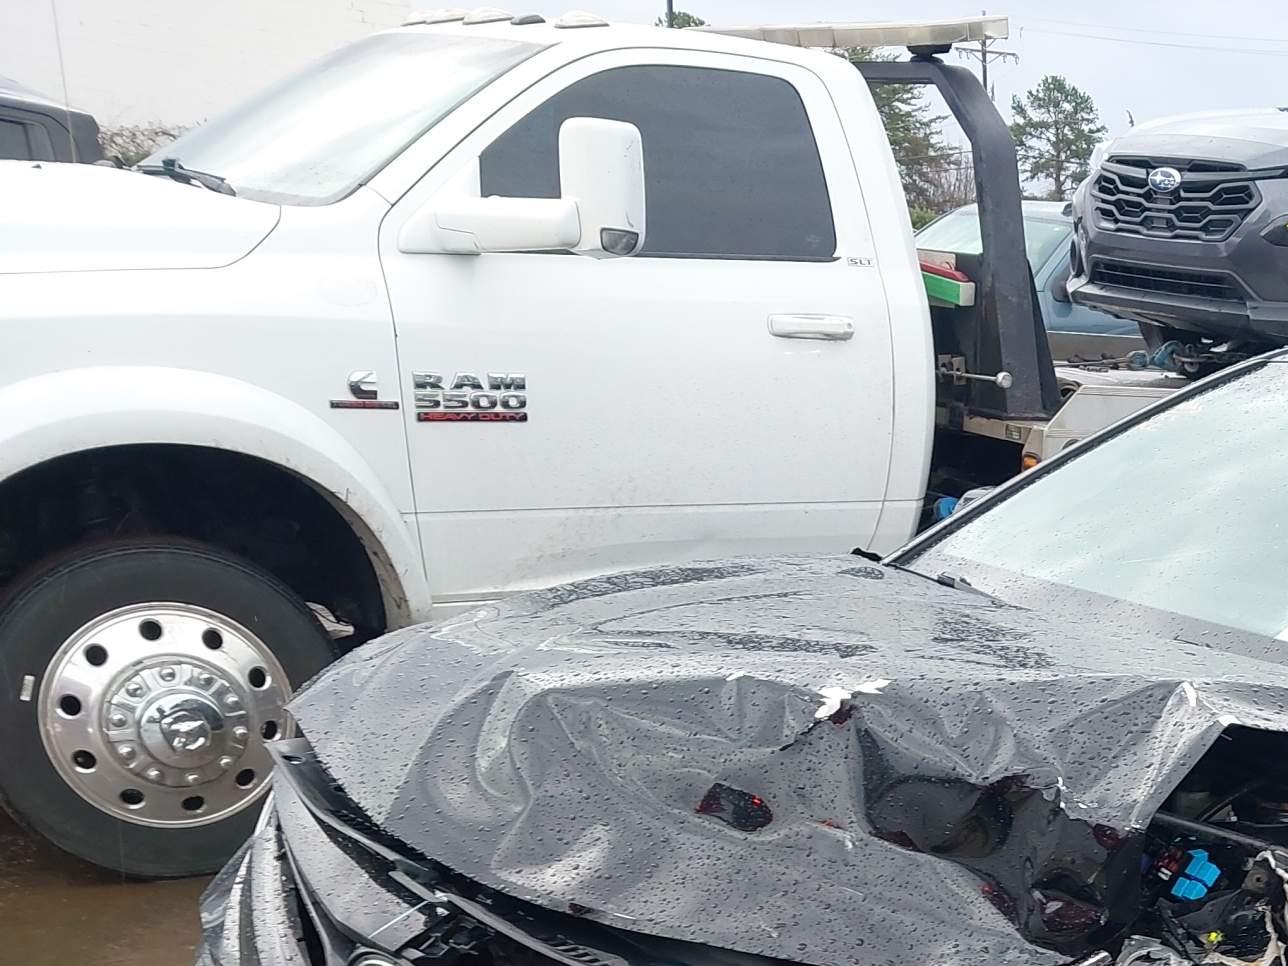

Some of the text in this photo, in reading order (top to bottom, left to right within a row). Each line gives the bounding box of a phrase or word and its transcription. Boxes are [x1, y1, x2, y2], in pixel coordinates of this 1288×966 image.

[850, 258, 872, 266] SLT
[412, 372, 526, 390] RAM
[414, 391, 527, 410] 5500
[420, 412, 524, 421] HEAVY DUTY
